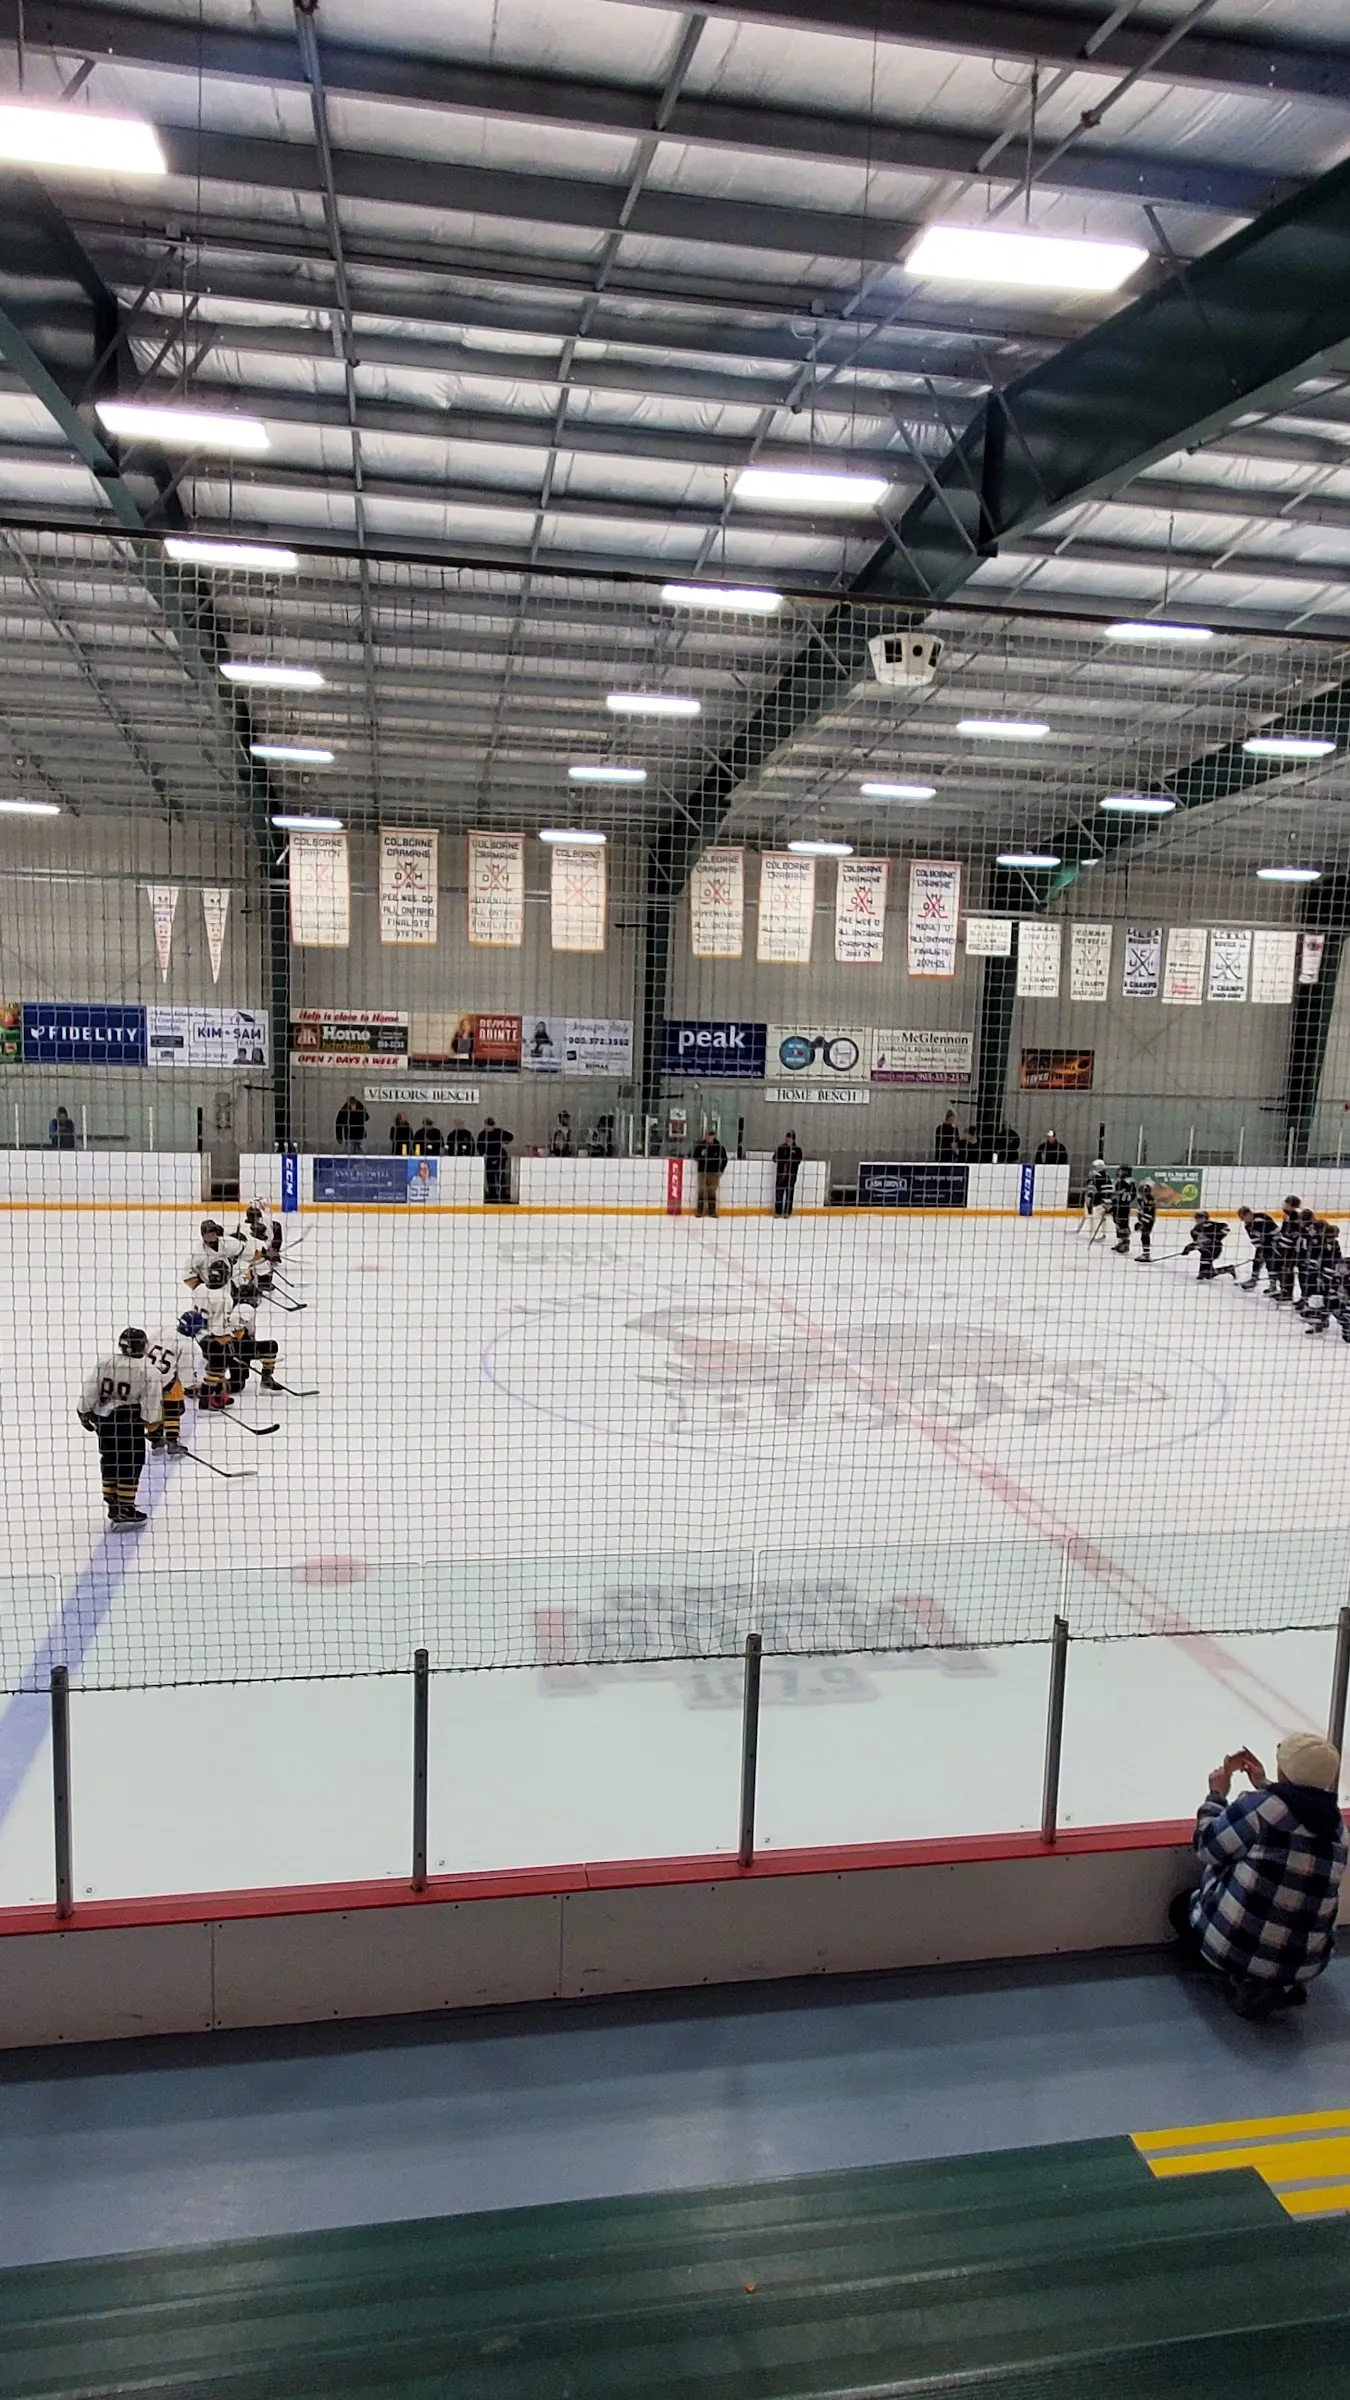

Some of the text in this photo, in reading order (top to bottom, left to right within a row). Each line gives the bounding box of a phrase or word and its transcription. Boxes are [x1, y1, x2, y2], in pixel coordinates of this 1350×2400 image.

[384, 837, 433, 848] COLBORNE
[299, 1011, 321, 1021] Help
[49, 1026, 138, 1042] FIDELITY
[197, 1027, 261, 1039] KIM SAM
[322, 1026, 371, 1041] Home
[678, 1025, 746, 1054] peak
[901, 1032, 969, 1045] McGlennon
[298, 1055, 323, 1063] OPEN
[336, 1056, 361, 1064] DAYS
[372, 1057, 400, 1065] WEEK
[369, 1088, 475, 1101] VISITORS BENCH
[777, 1089, 857, 1101] HOME BENCH
[285, 1158, 293, 1195] CCM
[1024, 1168, 1032, 1201] CCM
[147, 1345, 175, 1375] 55
